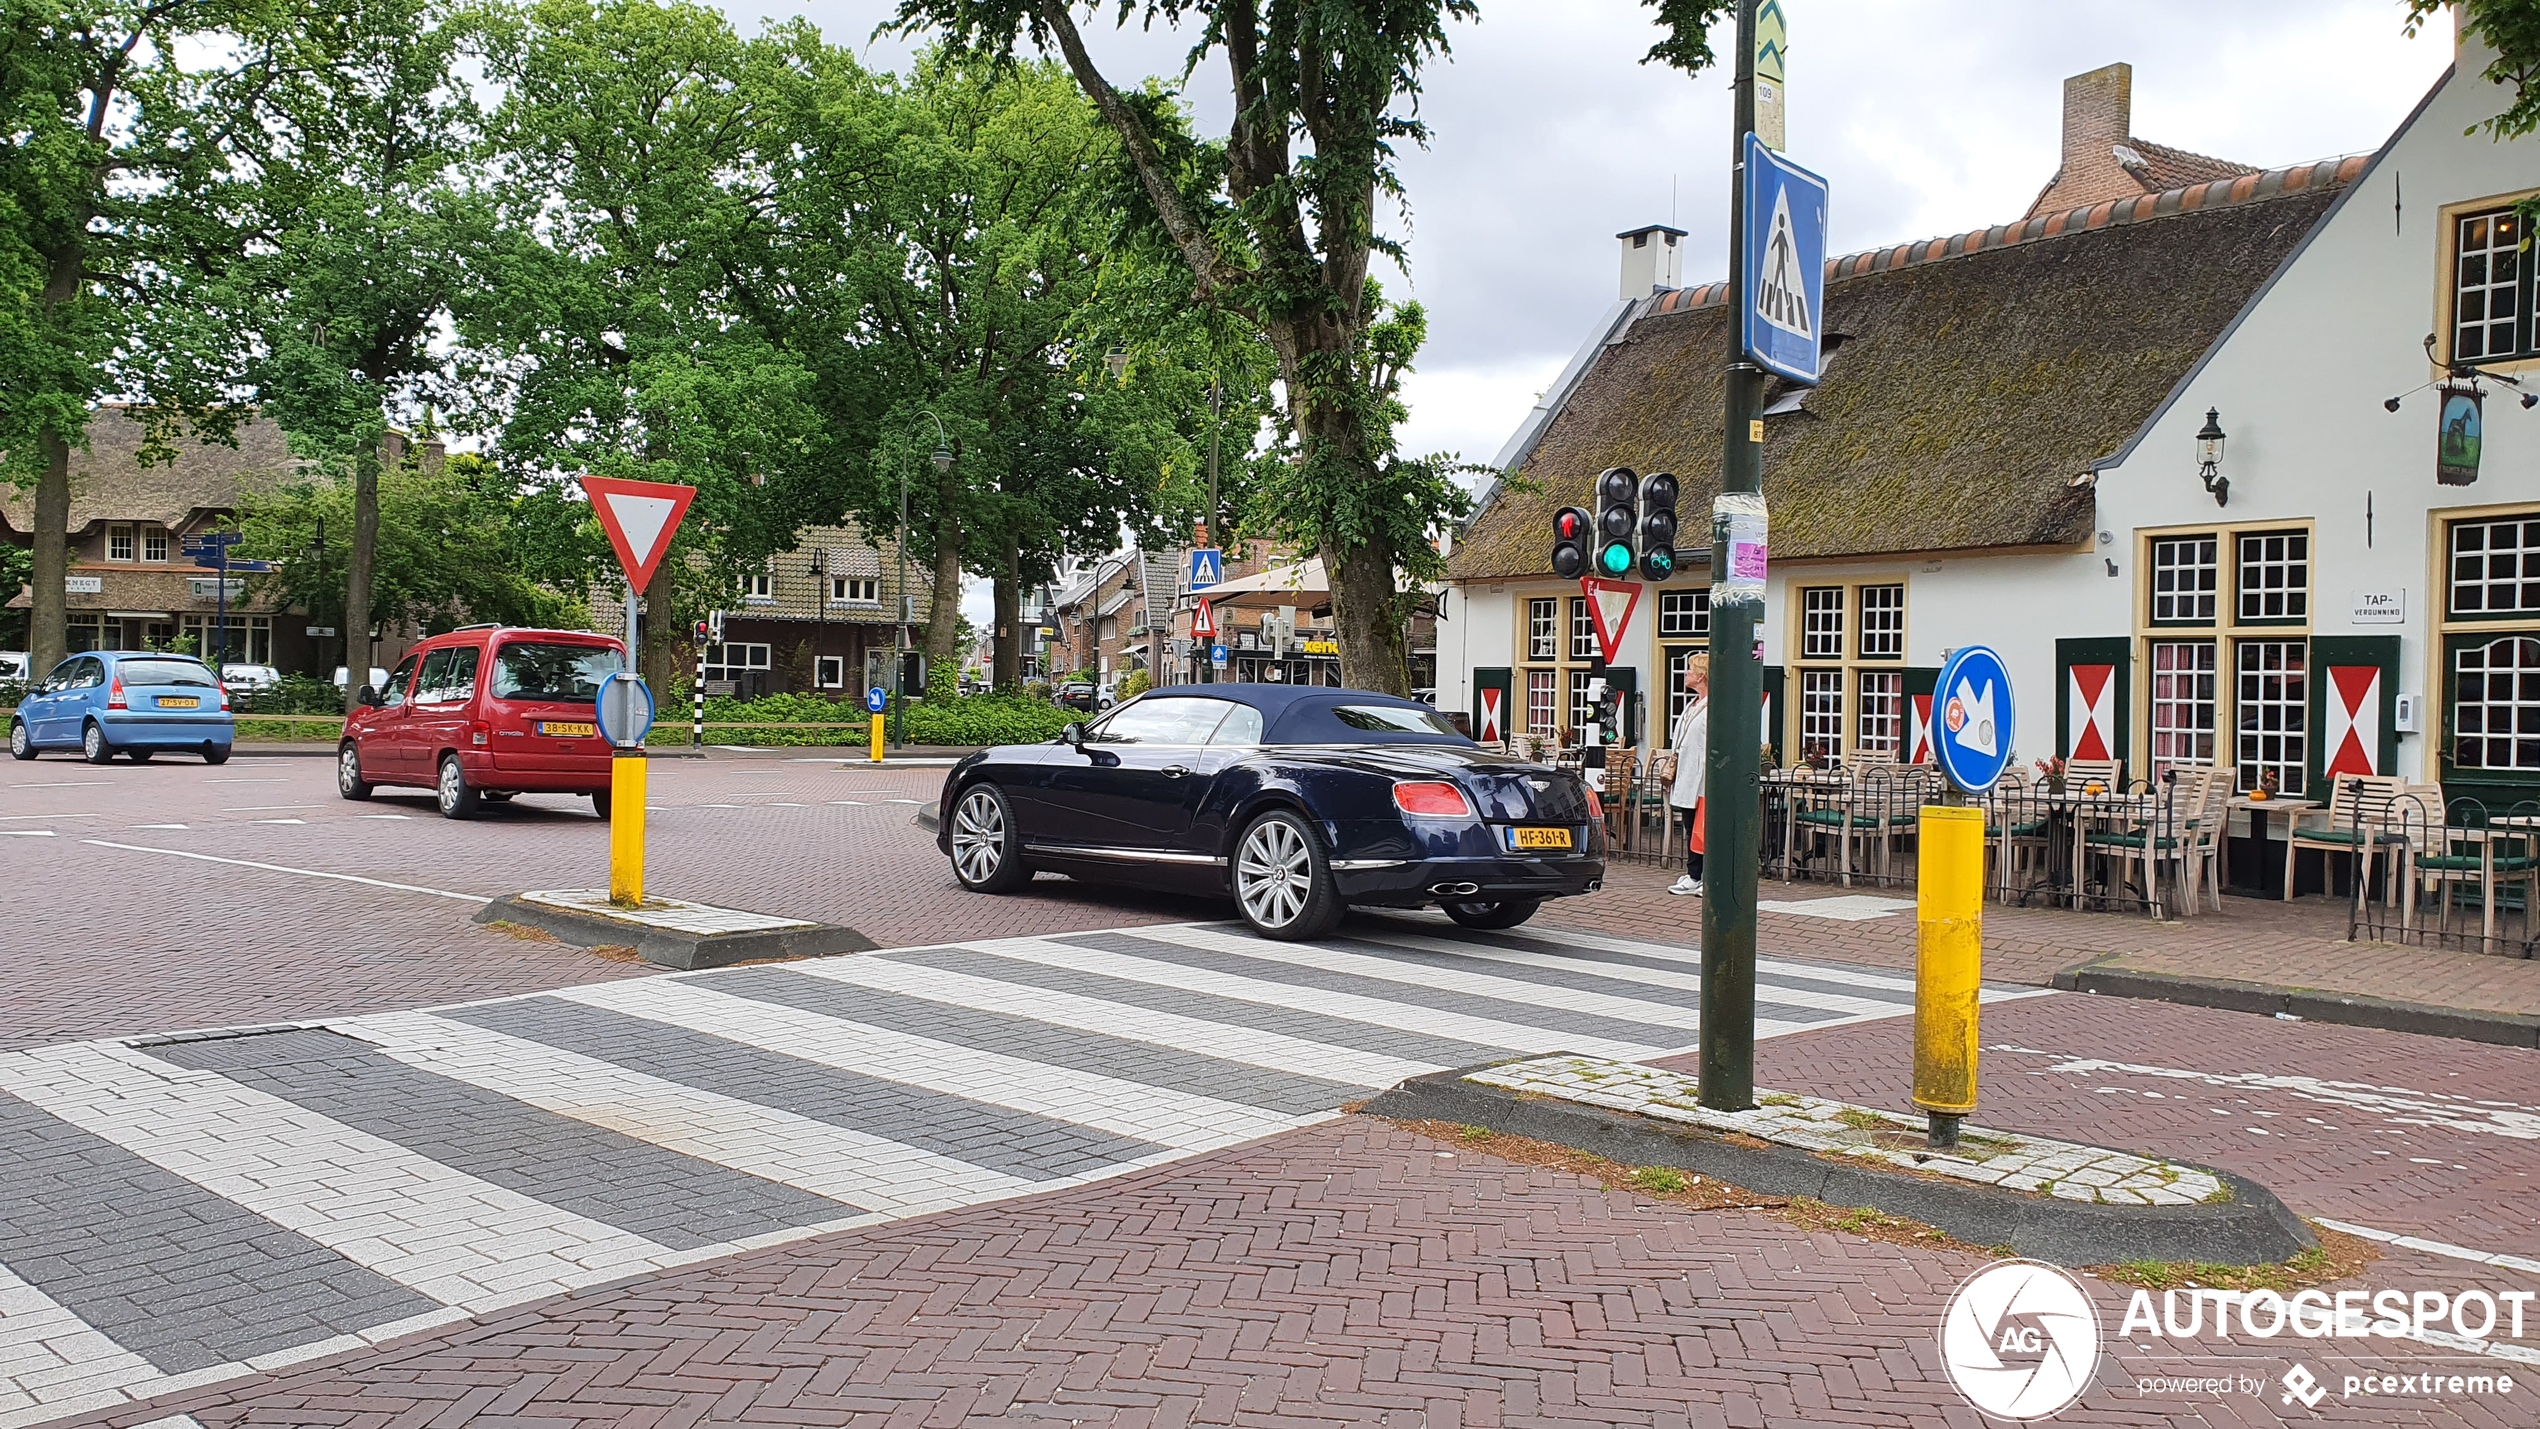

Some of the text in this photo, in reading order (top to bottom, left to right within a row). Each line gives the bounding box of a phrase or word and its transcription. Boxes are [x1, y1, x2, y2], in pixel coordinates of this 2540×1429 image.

[1759, 86, 1772, 99] 109
[2364, 594, 2393, 606] TAP-
[2354, 608, 2400, 616] VERGUNNING
[545, 723, 590, 734] 38-SK-KK
[1519, 830, 1567, 845] HF-361-R
